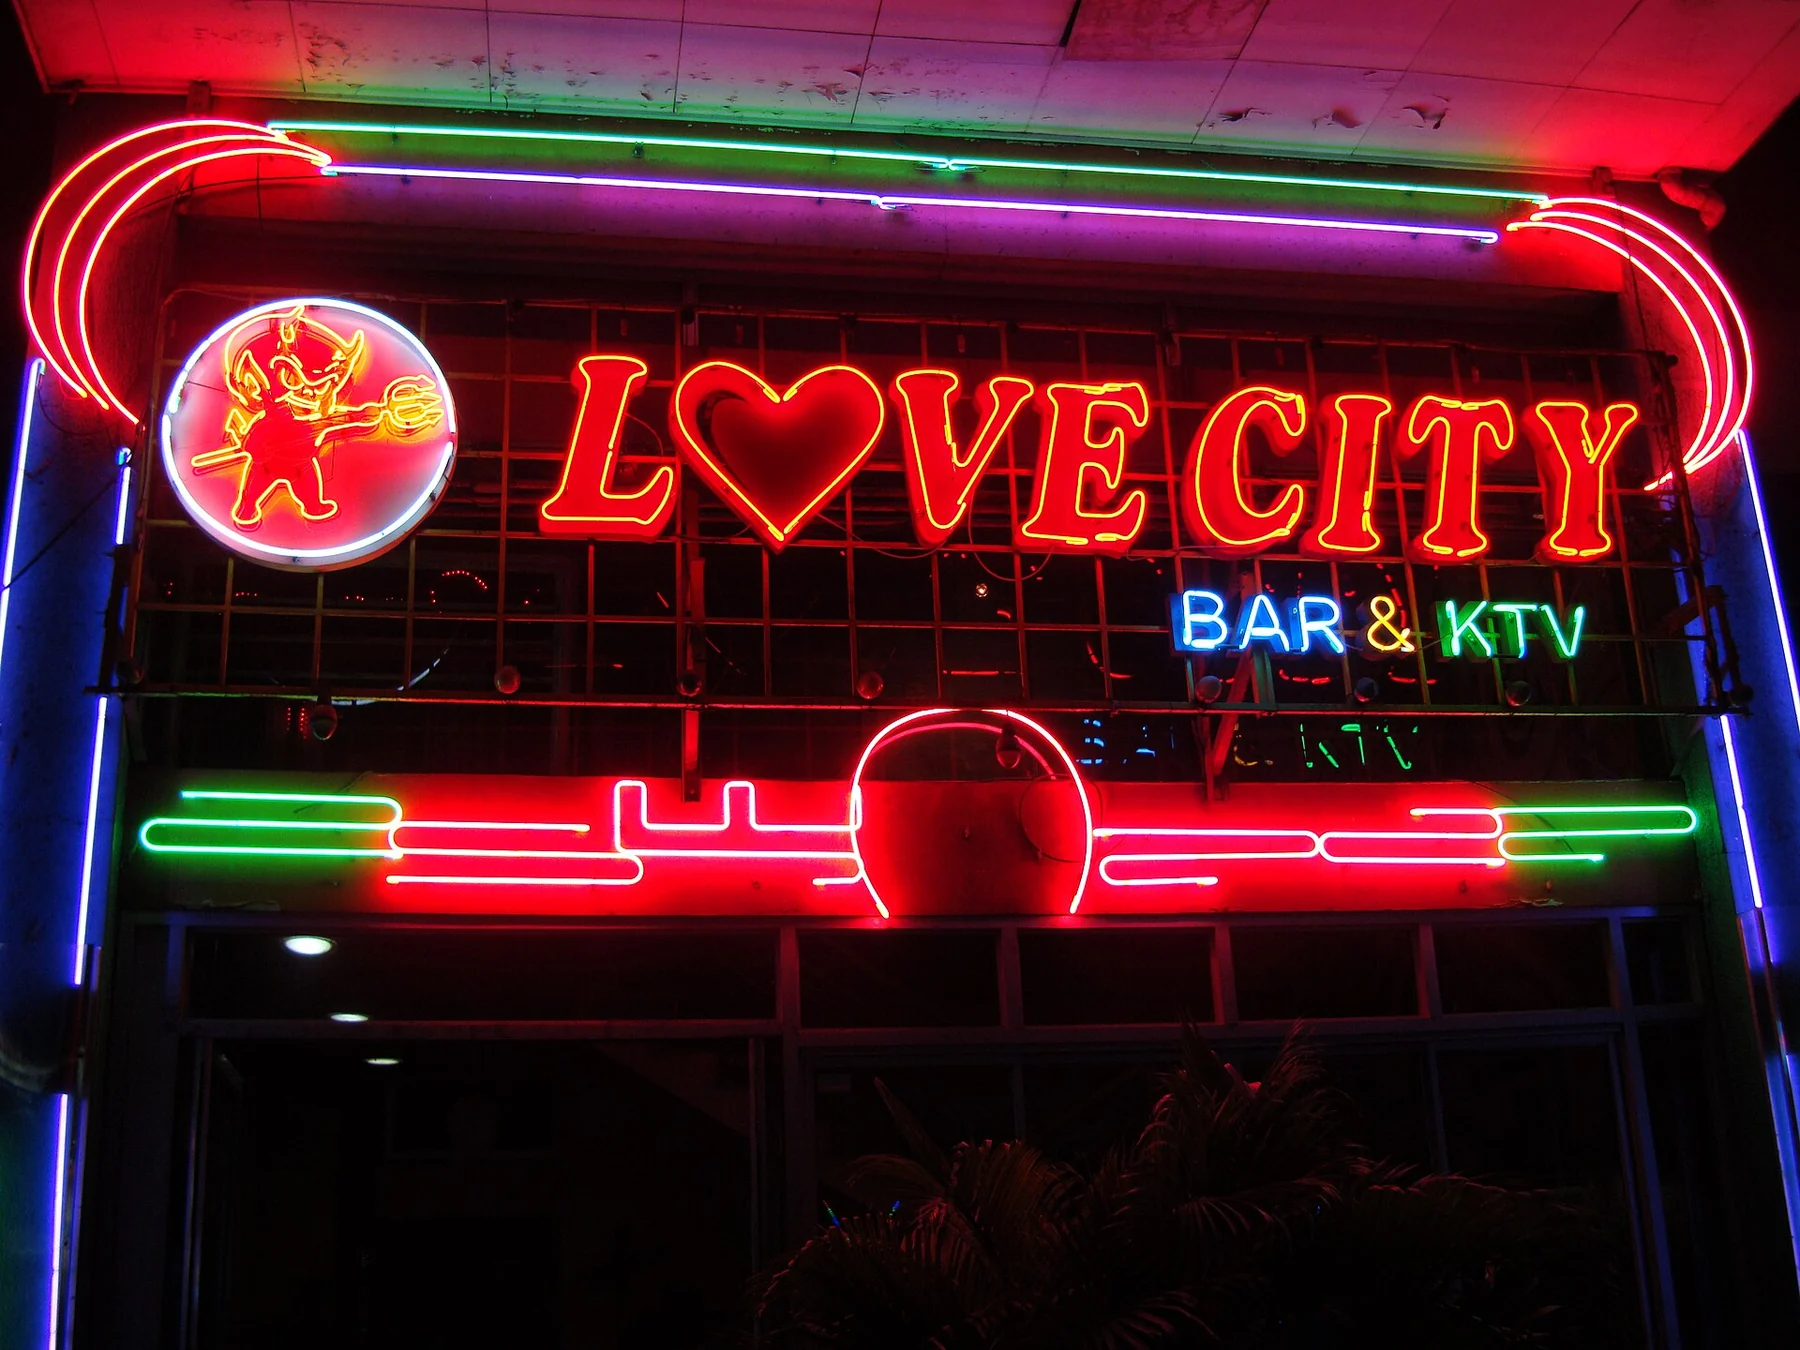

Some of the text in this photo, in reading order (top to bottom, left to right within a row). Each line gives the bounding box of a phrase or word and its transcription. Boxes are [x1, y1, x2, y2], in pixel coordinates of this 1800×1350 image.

[1190, 384, 1640, 560] CITY
[1178, 589, 1586, 660] BAR & KTV
